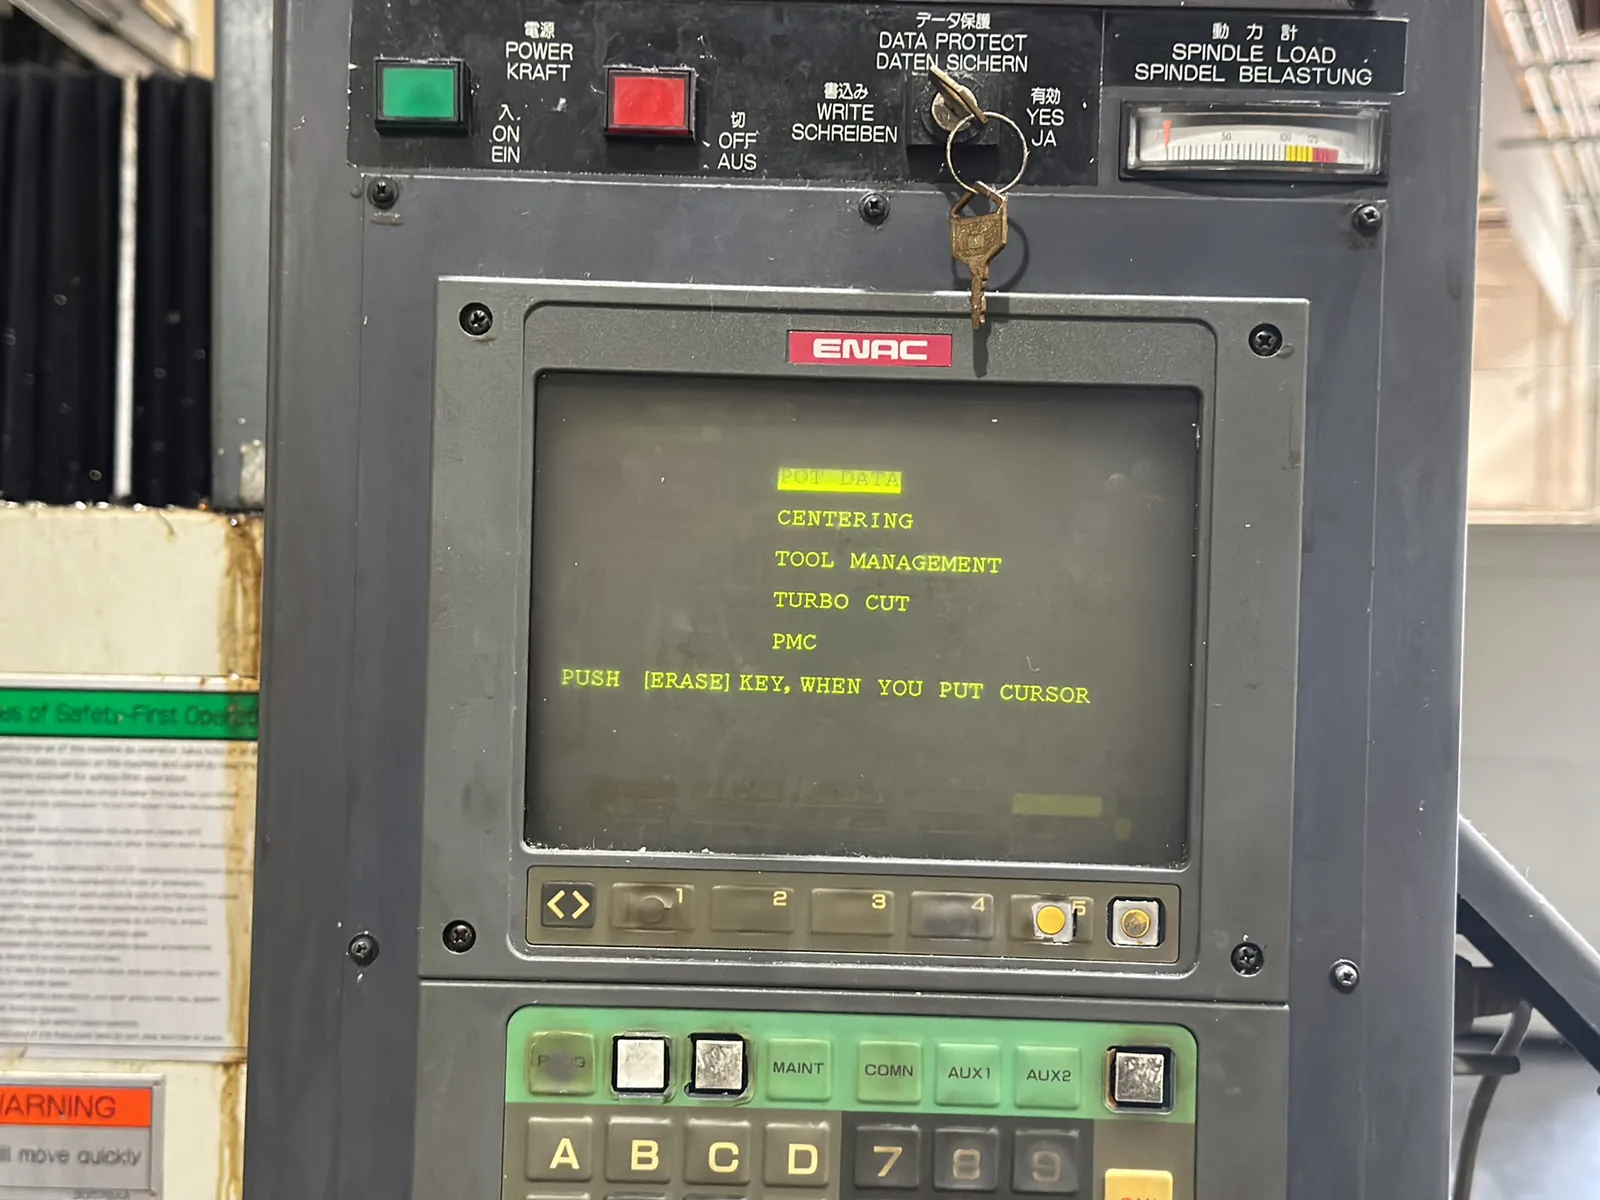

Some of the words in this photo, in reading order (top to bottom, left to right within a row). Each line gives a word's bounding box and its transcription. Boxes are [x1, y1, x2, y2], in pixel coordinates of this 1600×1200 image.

[524, 20, 555, 39] 電源
[916, 12, 991, 30] データ保護
[505, 41, 574, 61] POWER
[879, 31, 928, 50] DATA
[935, 33, 1028, 53] PROTECT
[876, 52, 939, 71] DATEN
[946, 53, 1029, 73] SICHERN
[1172, 43, 1264, 63] SPINDLE
[1277, 46, 1336, 64] LOAD
[506, 62, 571, 82] KRAFT
[1134, 63, 1226, 83] SPINDEL
[1239, 66, 1373, 86] BELASTUNG
[1030, 87, 1061, 105] 有効
[498, 103, 515, 121] 入
[730, 111, 746, 129] 切
[816, 103, 874, 122] WRITE
[1026, 108, 1065, 127] YES
[492, 124, 520, 143] ON
[718, 132, 757, 150] OFF
[791, 124, 898, 144] SCHREIBEN
[1031, 130, 1057, 147] JA
[1221, 132, 1232, 142] 50
[491, 145, 520, 164] EIN
[717, 153, 758, 171] AUS
[813, 338, 928, 361] ENAC
[780, 468, 824, 485] POT
[840, 470, 901, 487] DATA
[777, 509, 914, 530] CENTERING
[775, 550, 834, 569] TOOL
[849, 552, 1003, 574] MANAGEMENT
[773, 592, 849, 610] TURBO
[865, 595, 910, 612] CUT
[772, 633, 817, 651] PMC
[561, 669, 620, 688] PUSH
[644, 670, 730, 692] [ERASE]
[739, 674, 791, 694] KEY,
[800, 676, 861, 695] WHEN
[878, 679, 923, 697] YOU
[939, 682, 984, 699] PUT
[1000, 684, 1091, 705] CURSOR
[676, 888, 684, 904] 1
[772, 890, 787, 906] 2
[871, 893, 887, 909] 3
[970, 896, 986, 912] 4
[1072, 899, 1087, 916] 5
[772, 1060, 825, 1076] MAINT
[864, 1063, 914, 1078] COMN
[947, 1065, 991, 1081] AUX1
[1026, 1068, 1072, 1084] AUX2
[0, 1092, 116, 1120] ARNING
[19, 1147, 71, 1165] move
[549, 1137, 581, 1170] A
[630, 1139, 660, 1172] B
[708, 1141, 740, 1174] C
[787, 1142, 819, 1176] D
[873, 1145, 903, 1178] 7
[952, 1148, 981, 1180] 8
[1032, 1150, 1061, 1183] 9
